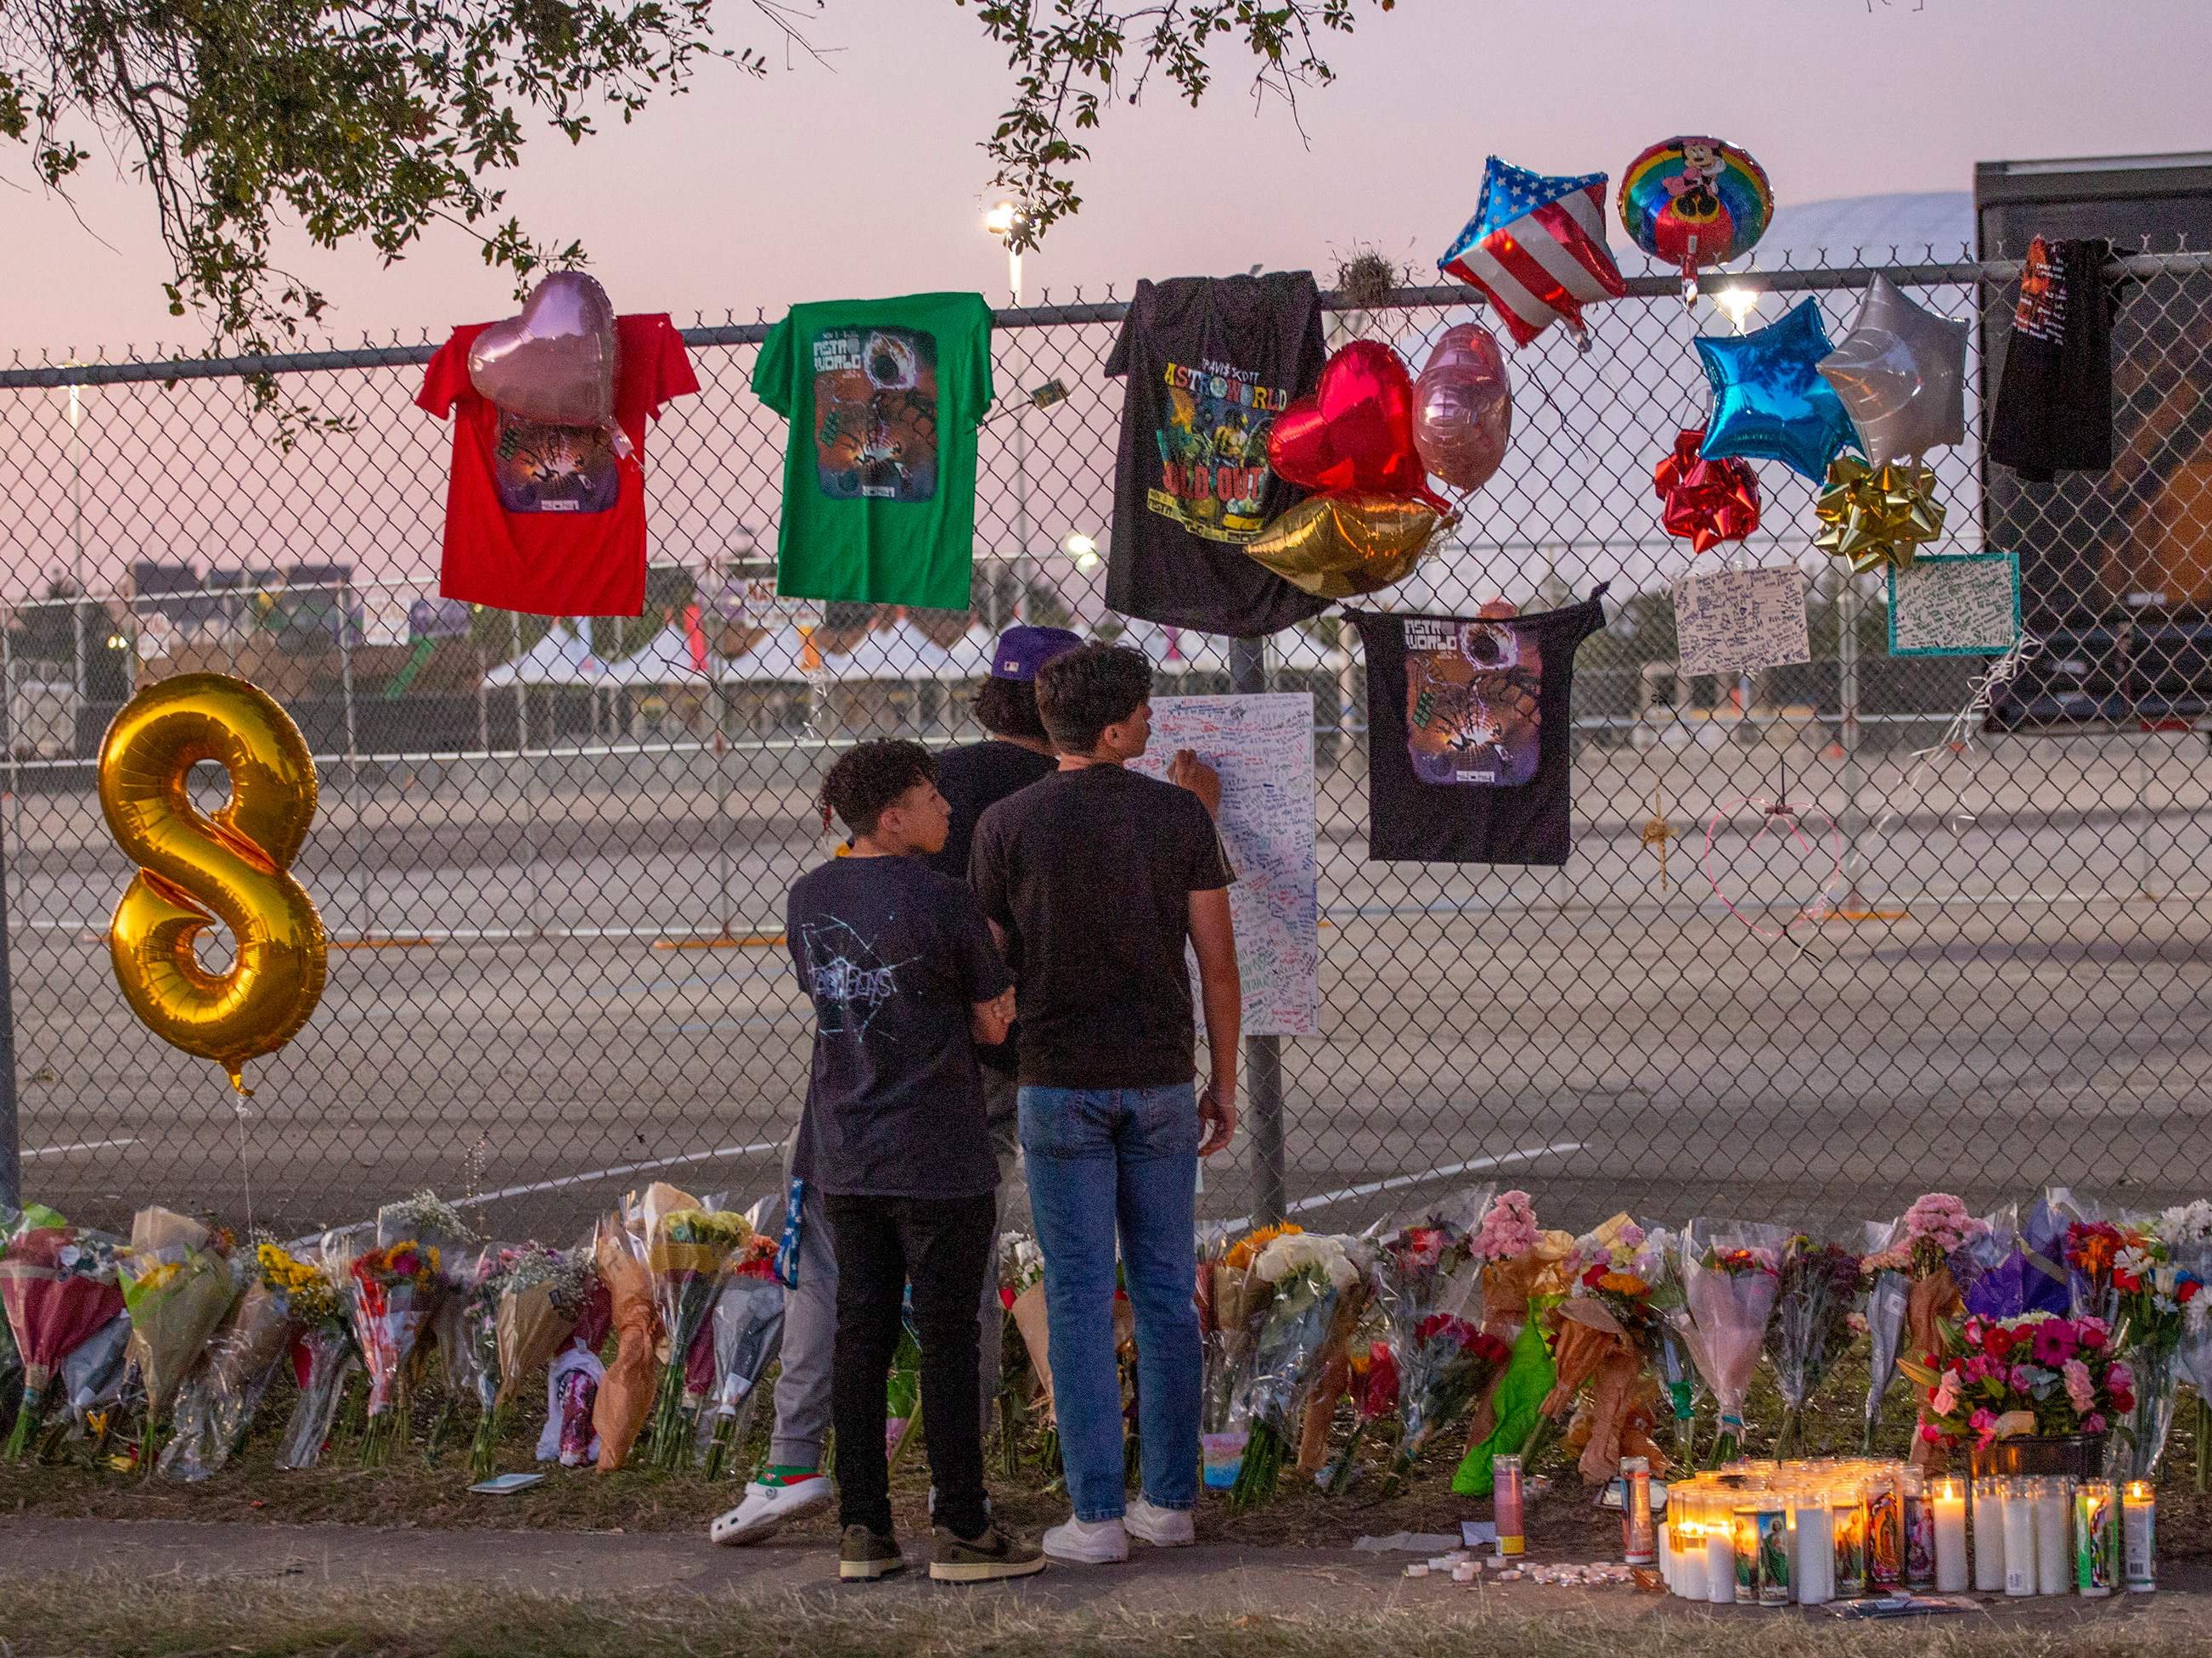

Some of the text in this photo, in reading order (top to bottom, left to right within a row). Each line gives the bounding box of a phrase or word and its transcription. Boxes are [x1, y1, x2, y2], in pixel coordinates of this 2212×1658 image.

[813, 339, 860, 355] ASTRO
[813, 354, 862, 372] WORLD
[1164, 363, 1288, 412] ASTROWORLD
[1217, 466, 1264, 502] OUT
[541, 500, 579, 511] 2021
[1404, 619, 1455, 635] ASTRO
[1405, 635, 1458, 650] WORLD
[1455, 770, 1494, 783] 2021
